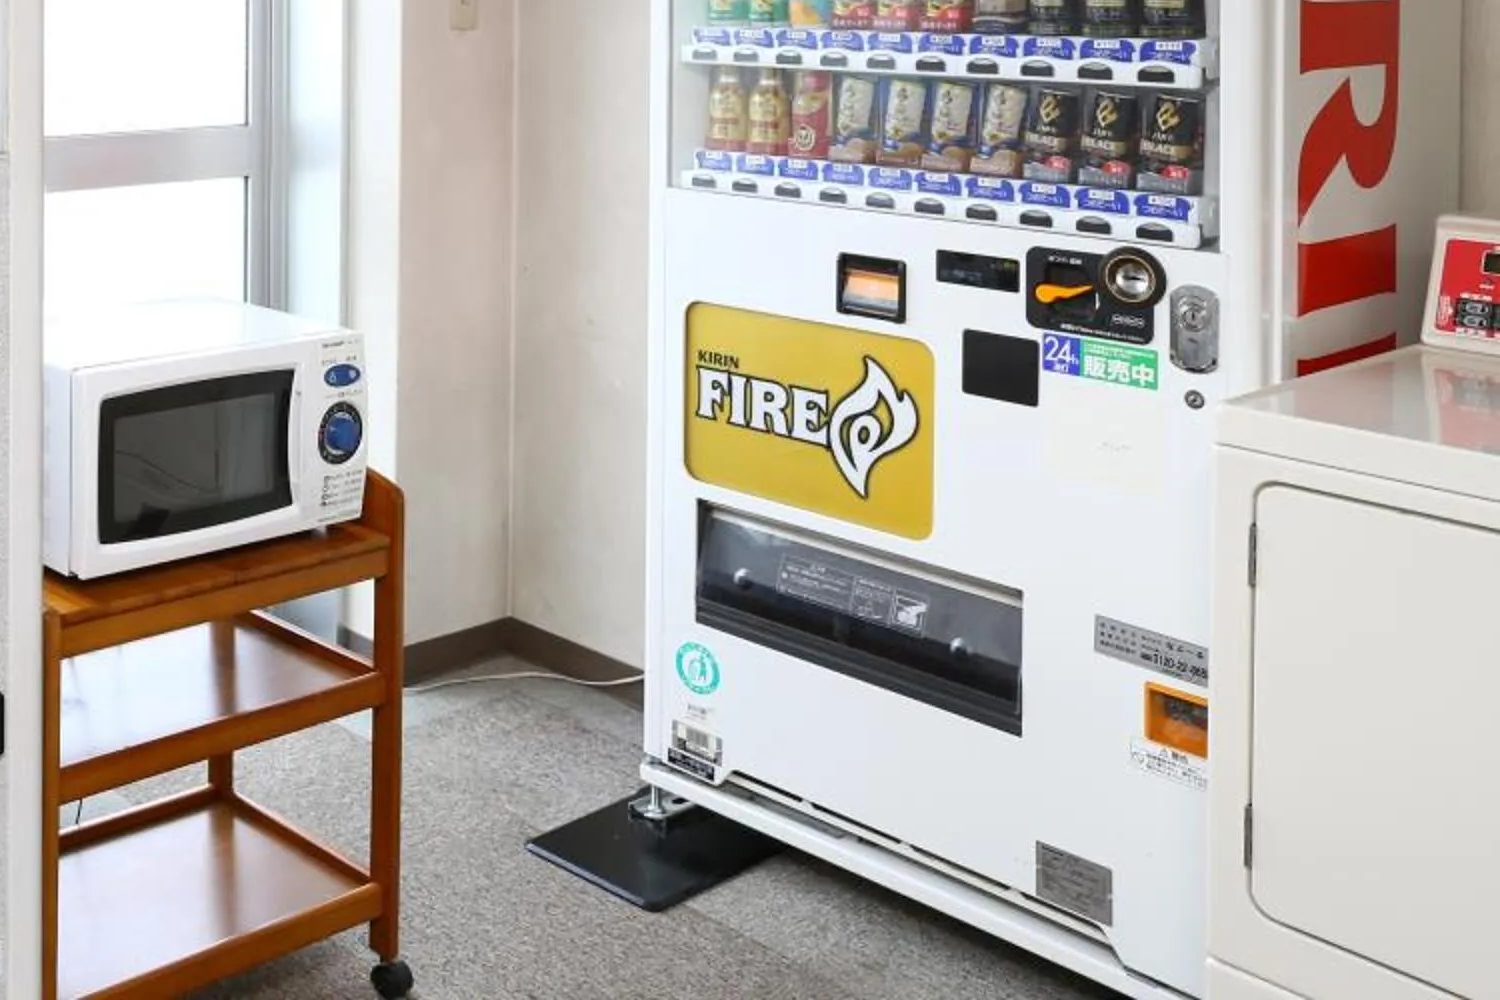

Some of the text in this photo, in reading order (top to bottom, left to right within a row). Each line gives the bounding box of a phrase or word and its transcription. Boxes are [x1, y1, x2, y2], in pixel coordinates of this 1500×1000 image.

[697, 350, 740, 369] KIRIN
[1084, 356, 1155, 387] 販売中
[696, 365, 830, 450] FIRE
